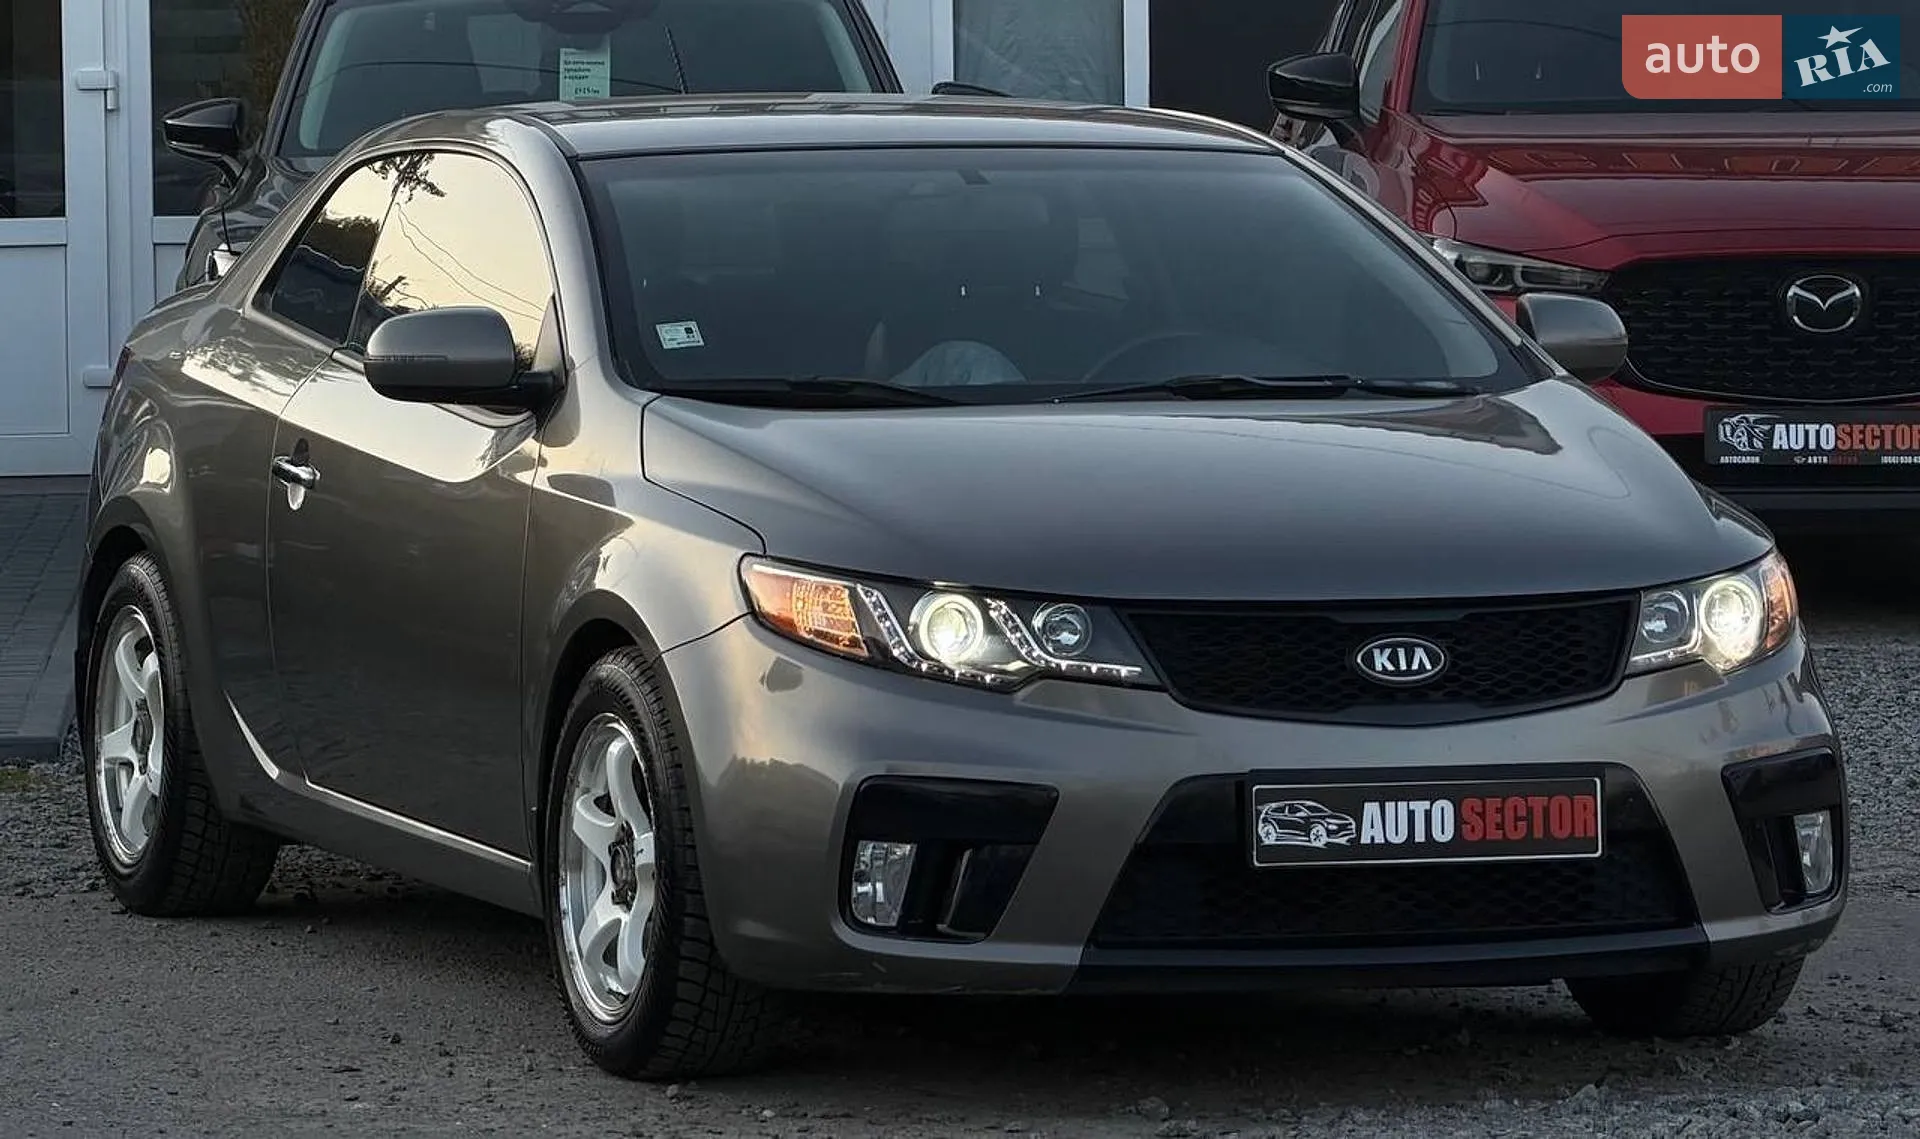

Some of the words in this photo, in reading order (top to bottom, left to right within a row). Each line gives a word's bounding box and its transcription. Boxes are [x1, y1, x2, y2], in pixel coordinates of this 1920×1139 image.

[1372, 647, 1433, 671] KIA
[1360, 799, 1455, 845] AUTO
[1461, 795, 1596, 841] SECTOR
